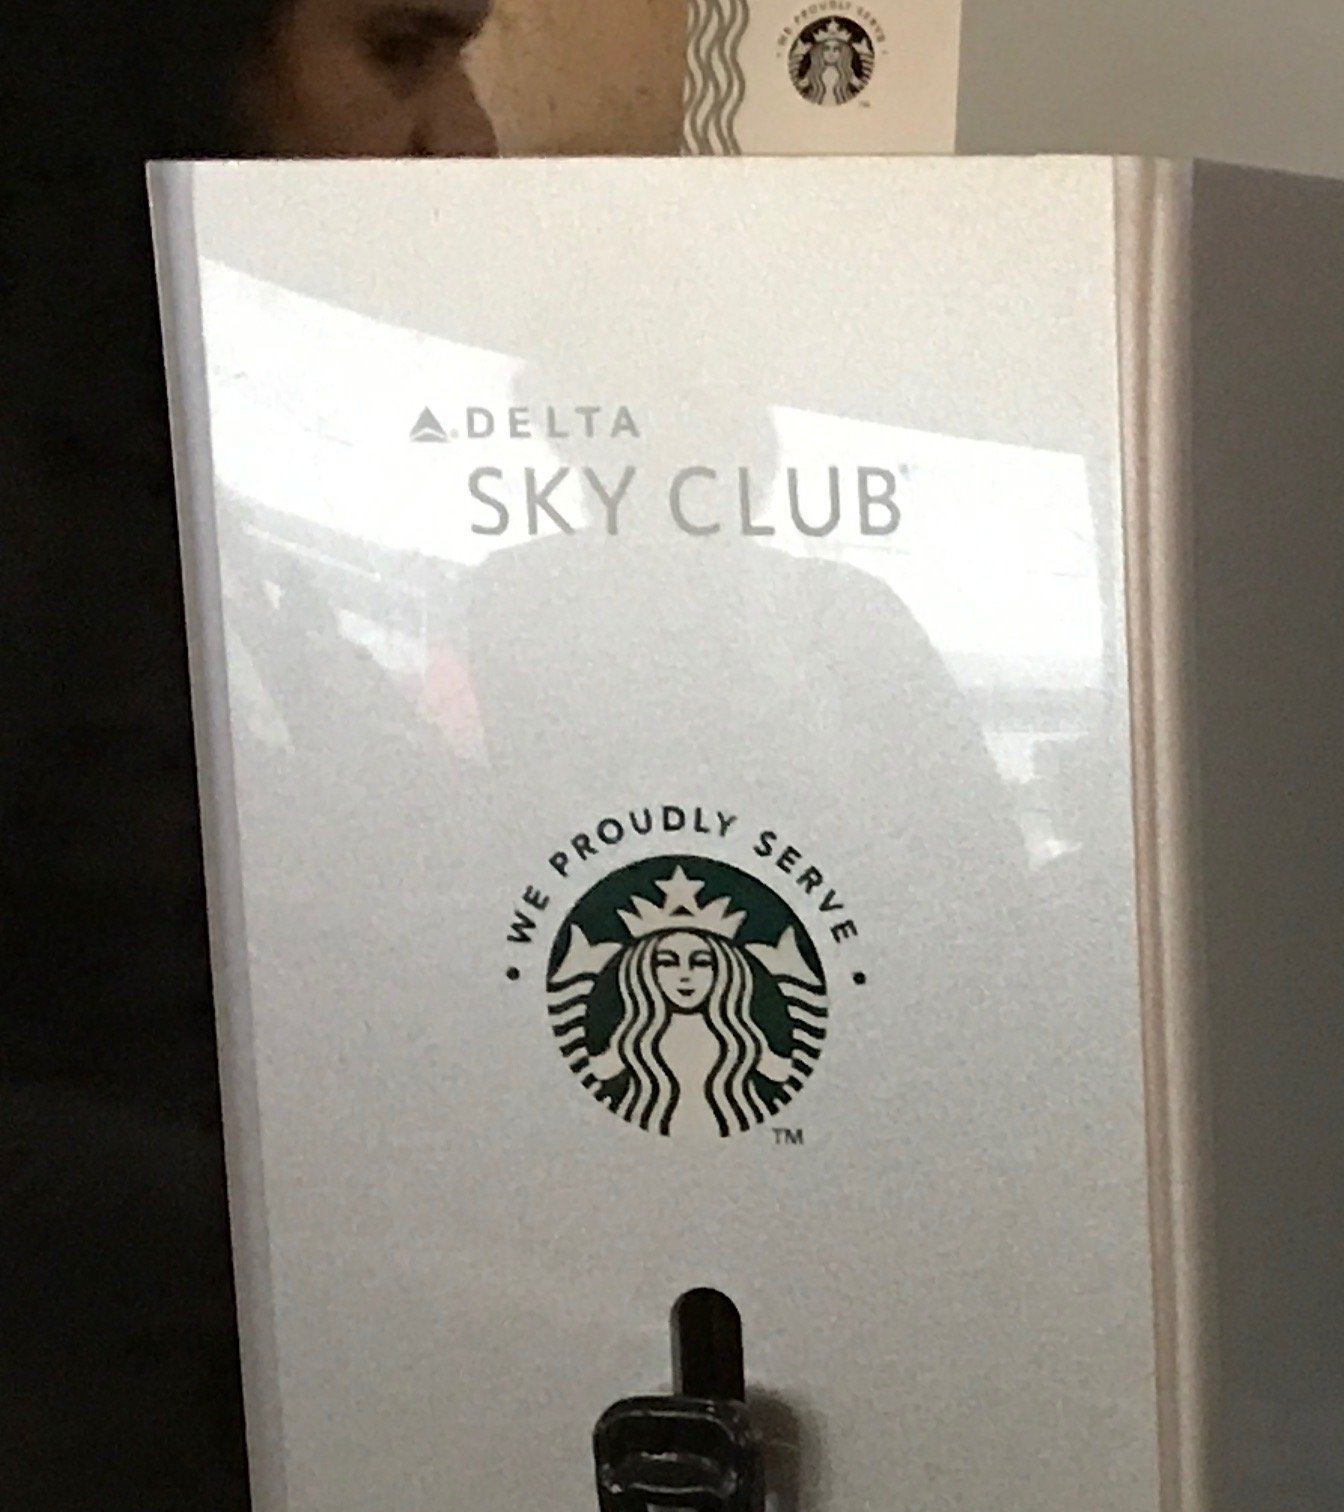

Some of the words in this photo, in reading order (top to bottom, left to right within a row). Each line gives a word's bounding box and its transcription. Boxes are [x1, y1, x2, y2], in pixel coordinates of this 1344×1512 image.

[466, 406, 640, 438] DELTA
[468, 466, 636, 536] SKY
[670, 466, 902, 536] CLUB
[507, 885, 550, 944] WE
[548, 805, 737, 877] PROUDLY
[752, 830, 858, 944] SERVE
[772, 1128, 804, 1145] TM
